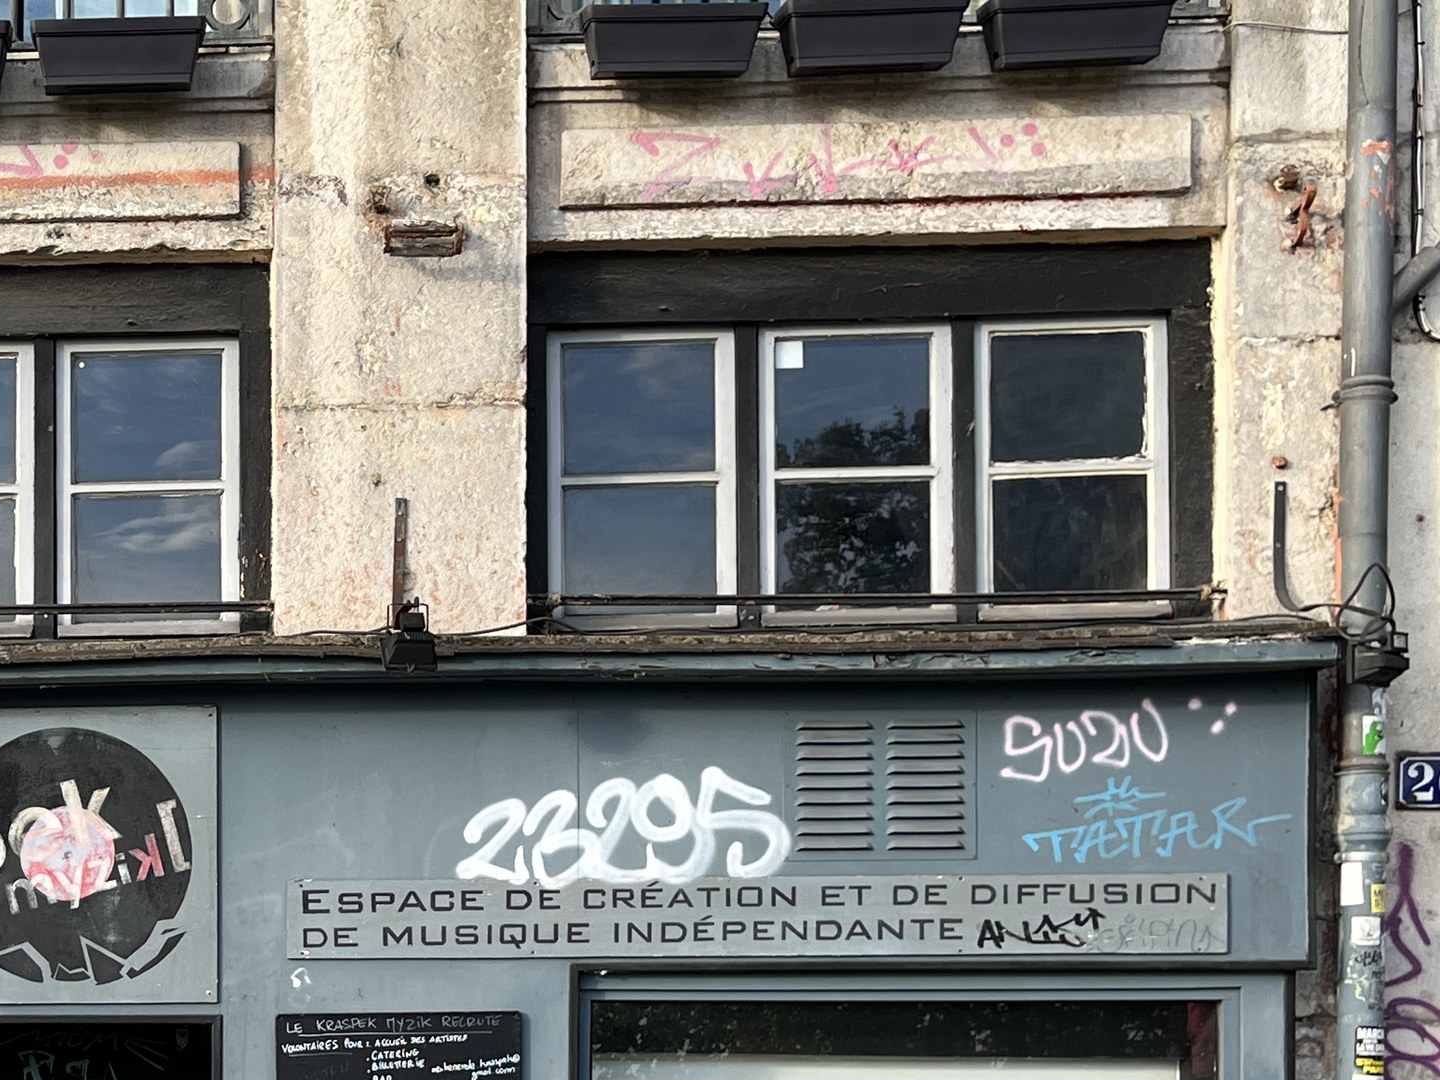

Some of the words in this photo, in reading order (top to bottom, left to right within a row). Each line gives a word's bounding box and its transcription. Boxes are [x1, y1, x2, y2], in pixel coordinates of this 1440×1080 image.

[1407, 762, 1440, 802] 2
[302, 889, 485, 914] ESPACE
[506, 889, 561, 910] DE
[584, 881, 797, 909] CRÉATION
[821, 885, 872, 906] ET
[893, 884, 948, 905] DE
[971, 883, 1216, 905] DIFFUSION
[303, 927, 358, 948] DE
[383, 923, 590, 949] MUSIQUE
[614, 915, 963, 943] INDÉPENDANTE
[286, 1022, 303, 1034] LE
[316, 1017, 377, 1031] KRASPEK
[442, 1014, 503, 1028] RECRUTE
[281, 1039, 339, 1053] VOLONTAIRES
[411, 1036, 425, 1044] DES
